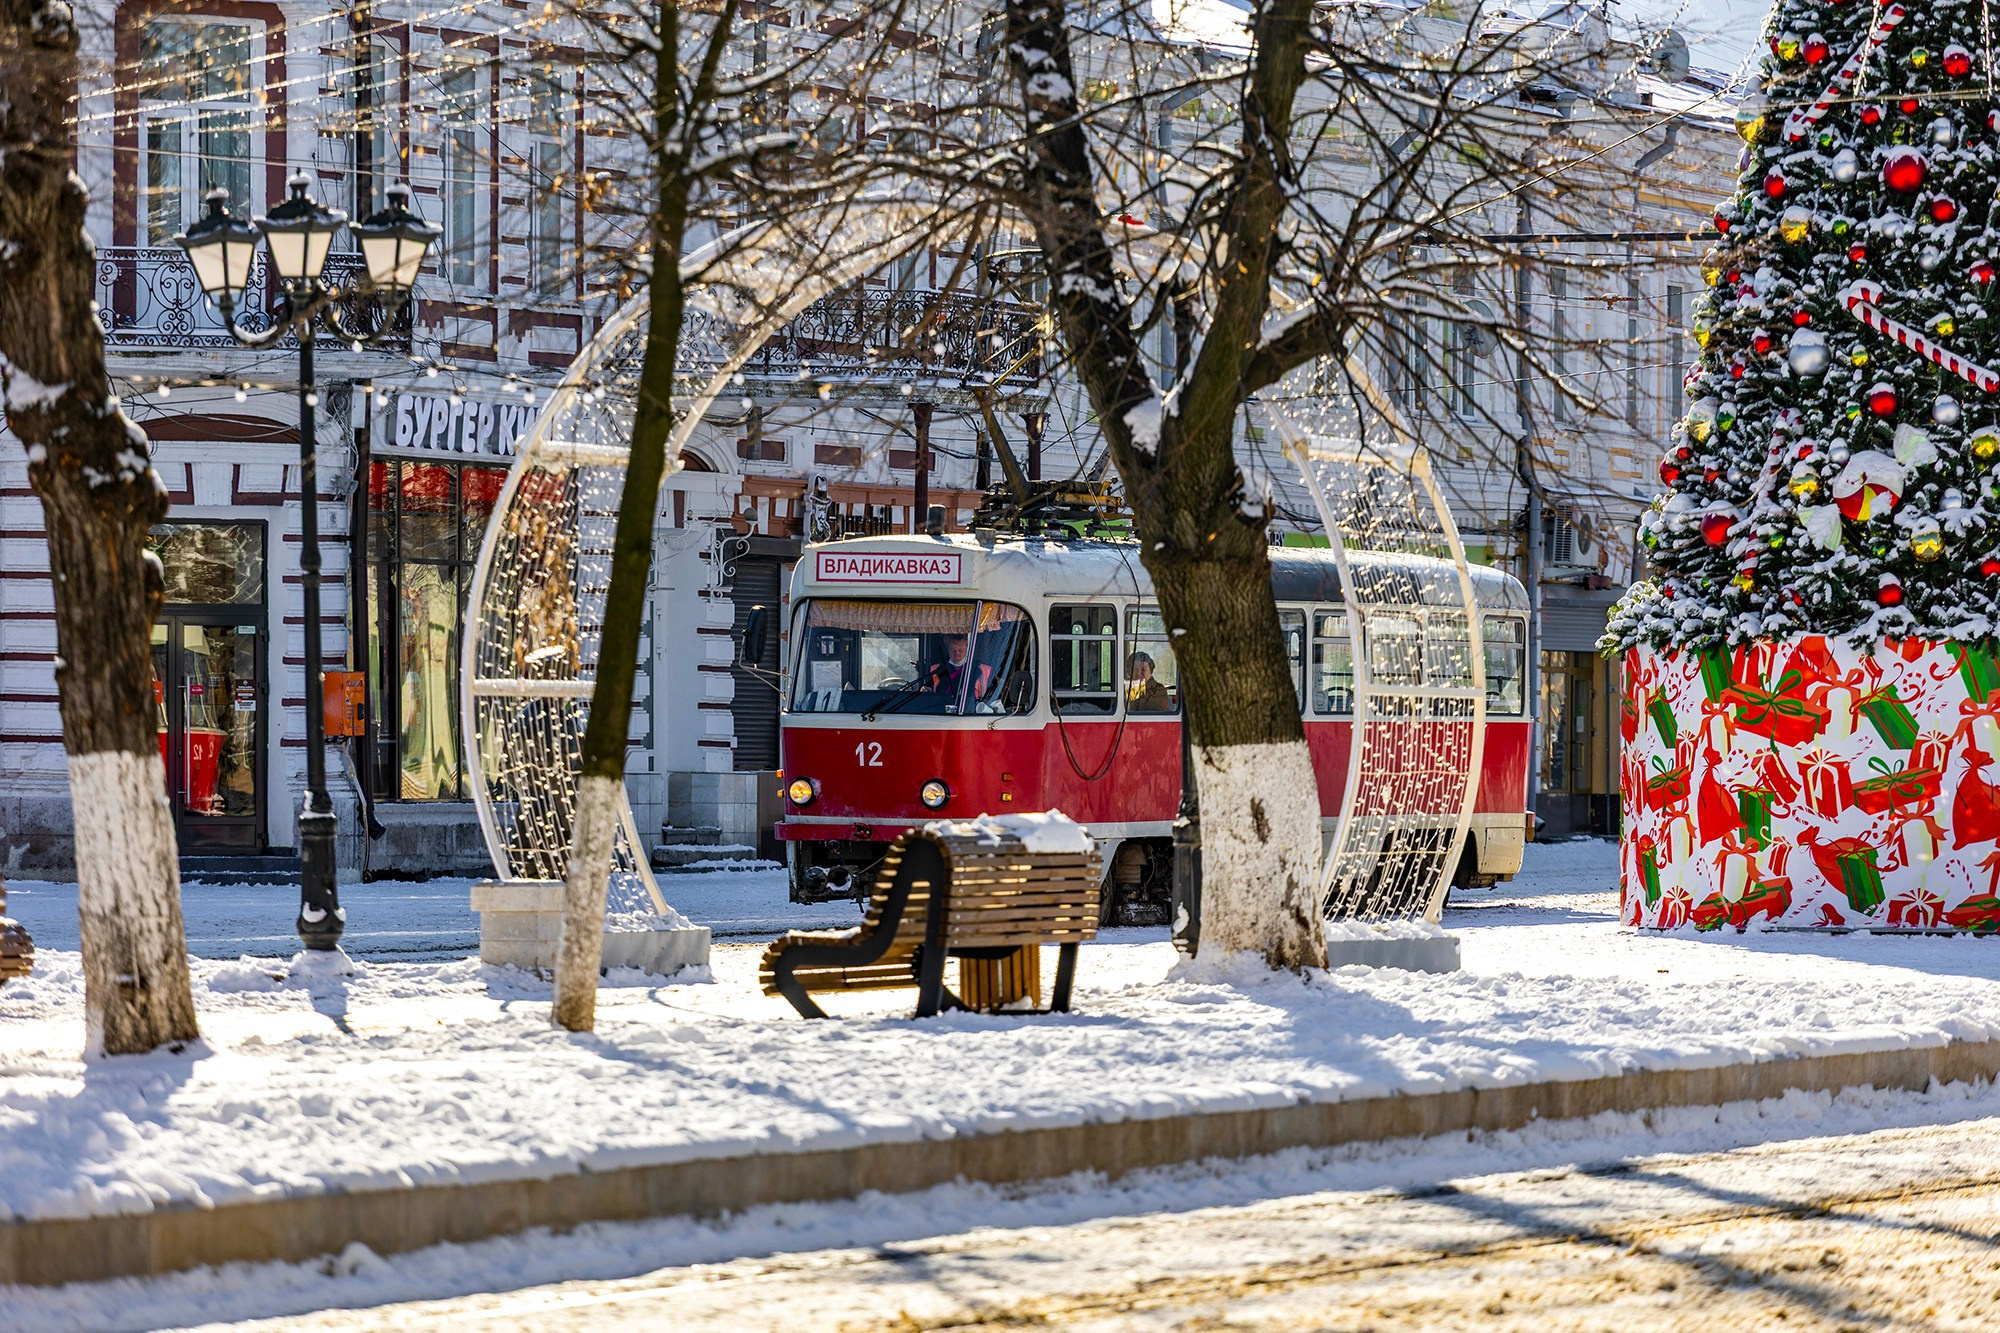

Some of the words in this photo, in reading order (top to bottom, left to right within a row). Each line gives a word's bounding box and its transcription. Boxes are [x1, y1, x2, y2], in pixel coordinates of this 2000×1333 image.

[395, 394, 495, 453] БУРГЕР
[824, 558, 951, 577] ВЛАДИКАВКАЗ
[855, 741, 883, 767] 12
